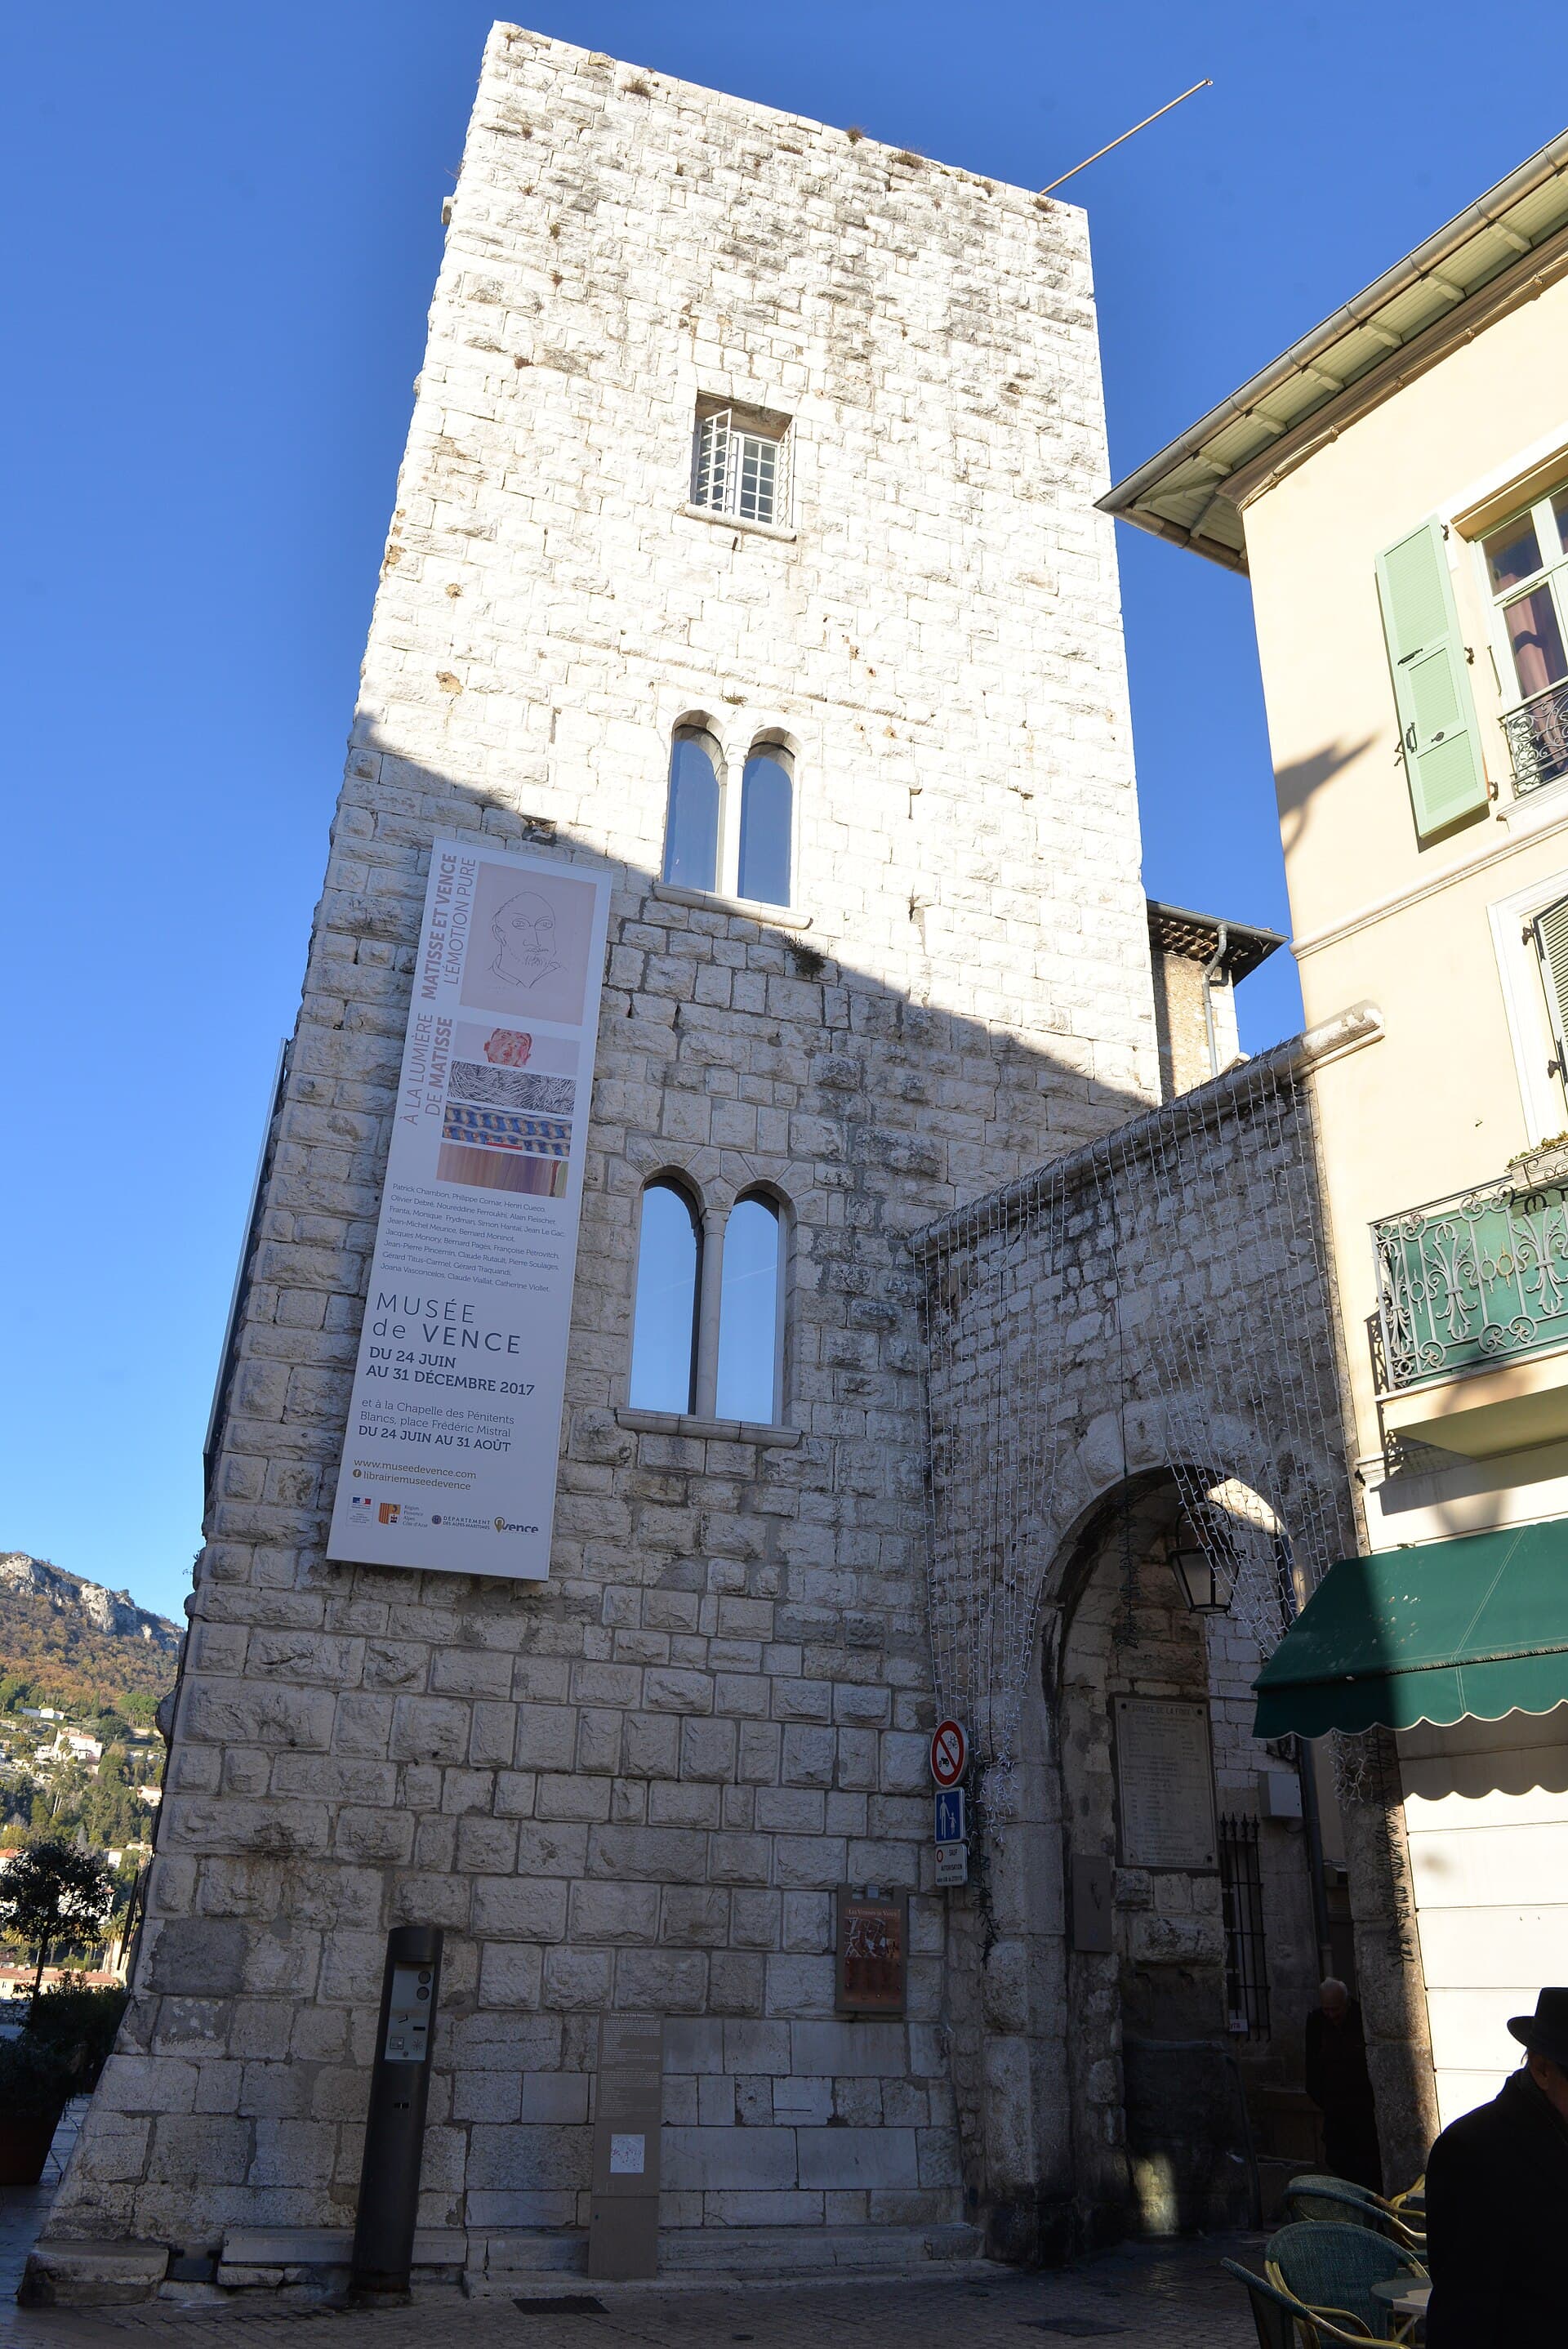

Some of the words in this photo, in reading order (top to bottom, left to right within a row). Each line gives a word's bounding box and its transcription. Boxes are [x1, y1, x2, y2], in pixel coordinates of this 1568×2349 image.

[435, 854, 457, 904] VENCE
[457, 858, 476, 897] PURE
[432, 908, 448, 929] ET
[421, 931, 445, 1001] MATISSE
[408, 1013, 433, 1083] LUMIÈRE
[429, 1017, 452, 1088] MATISSE
[405, 1089, 423, 1108] LA
[425, 1093, 442, 1116] DE
[399, 1115, 418, 1125] À
[376, 1292, 475, 1323] MUSÉE
[372, 1318, 406, 1339] de
[422, 1323, 520, 1354] VENCE
[369, 1346, 393, 1360] DU
[395, 1350, 415, 1363] 24
[418, 1353, 457, 1369] JUIN
[365, 1364, 390, 1378] AU
[392, 1367, 409, 1381] 31
[414, 1371, 496, 1392] DÉCEMBRE
[500, 1381, 535, 1396] 2017
[360, 1411, 397, 1425] Blancs,
[399, 1416, 429, 1428] place
[432, 1419, 474, 1433] Frédéric
[476, 1424, 510, 1437] Mistral
[361, 1399, 372, 1407] et
[375, 1399, 381, 1409] à
[385, 1400, 394, 1411] la
[397, 1402, 443, 1416] Chapelle
[445, 1408, 464, 1419] des
[467, 1410, 514, 1424] Pénitents
[359, 1424, 378, 1437] DU
[381, 1428, 397, 1439] 24
[399, 1430, 432, 1443] JUIN
[434, 1434, 454, 1446] AU
[457, 1437, 470, 1447] 31
[473, 1438, 511, 1452] AOÛT
[354, 1459, 476, 1479] www.museedevence.com
[363, 1471, 471, 1491] librairiemuseedevence
